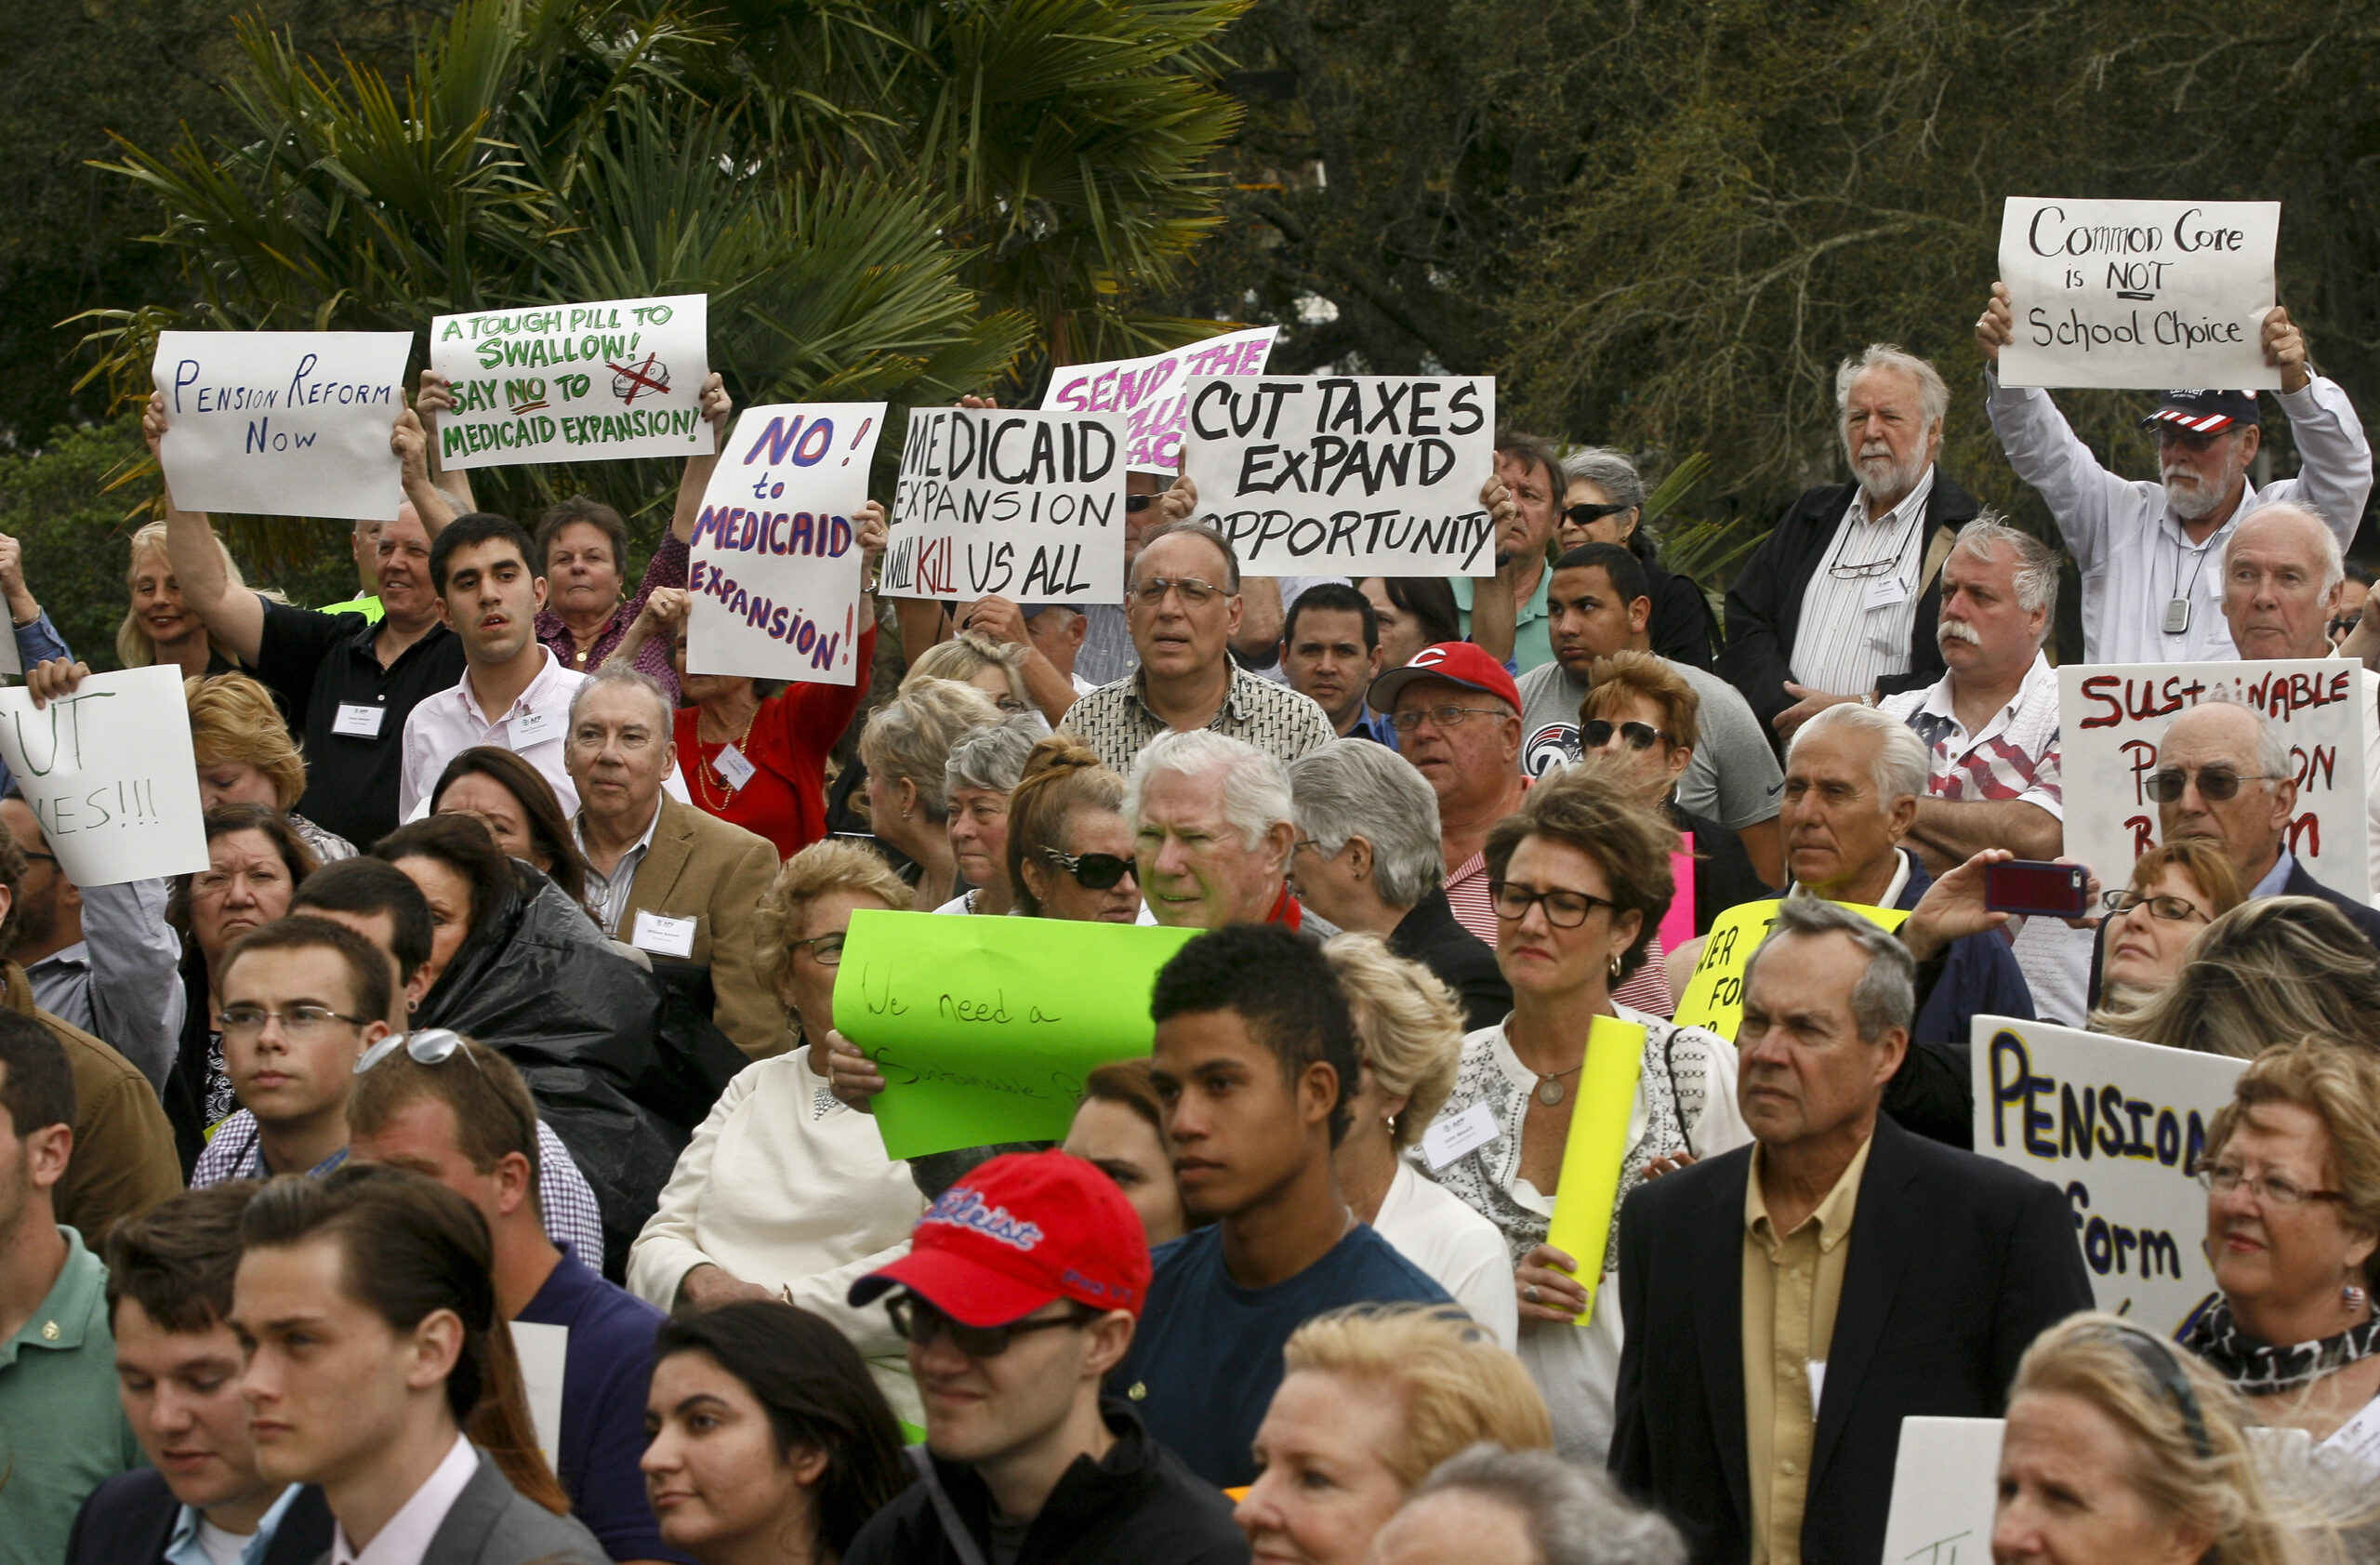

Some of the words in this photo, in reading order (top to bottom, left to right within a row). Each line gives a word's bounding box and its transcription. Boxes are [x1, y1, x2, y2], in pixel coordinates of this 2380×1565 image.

[2175, 208, 2243, 252] Core
[2066, 262, 2083, 289] is
[2106, 261, 2174, 290] NOT
[442, 319, 463, 342] A
[469, 311, 562, 337] TOUGH
[569, 307, 622, 331] PILL
[631, 304, 674, 327] TO
[2029, 306, 2145, 351] School
[2153, 310, 2244, 349] Choice
[479, 332, 640, 370] SWALLOW!
[450, 377, 497, 416] SAY
[507, 377, 546, 407] NO
[555, 373, 590, 400] TO
[1056, 357, 1179, 412] SEND
[1184, 338, 1271, 376] THE
[443, 415, 556, 459] MEDICAID
[562, 405, 701, 446] EXPANSION!
[1191, 380, 1303, 440] CUT
[1316, 379, 1485, 437] TAXES
[899, 412, 1116, 485] MEDICAID
[752, 471, 785, 499] to
[892, 480, 1116, 527] EXPANSION
[691, 505, 853, 558] MEDICAID
[968, 540, 1015, 595] US
[1023, 544, 1091, 596] ALL
[0, 692, 116, 779] UT
[862, 960, 909, 1015] We
[939, 988, 1013, 1024] need
[1029, 1003, 1061, 1023] a
[1709, 977, 1742, 1010] FO
